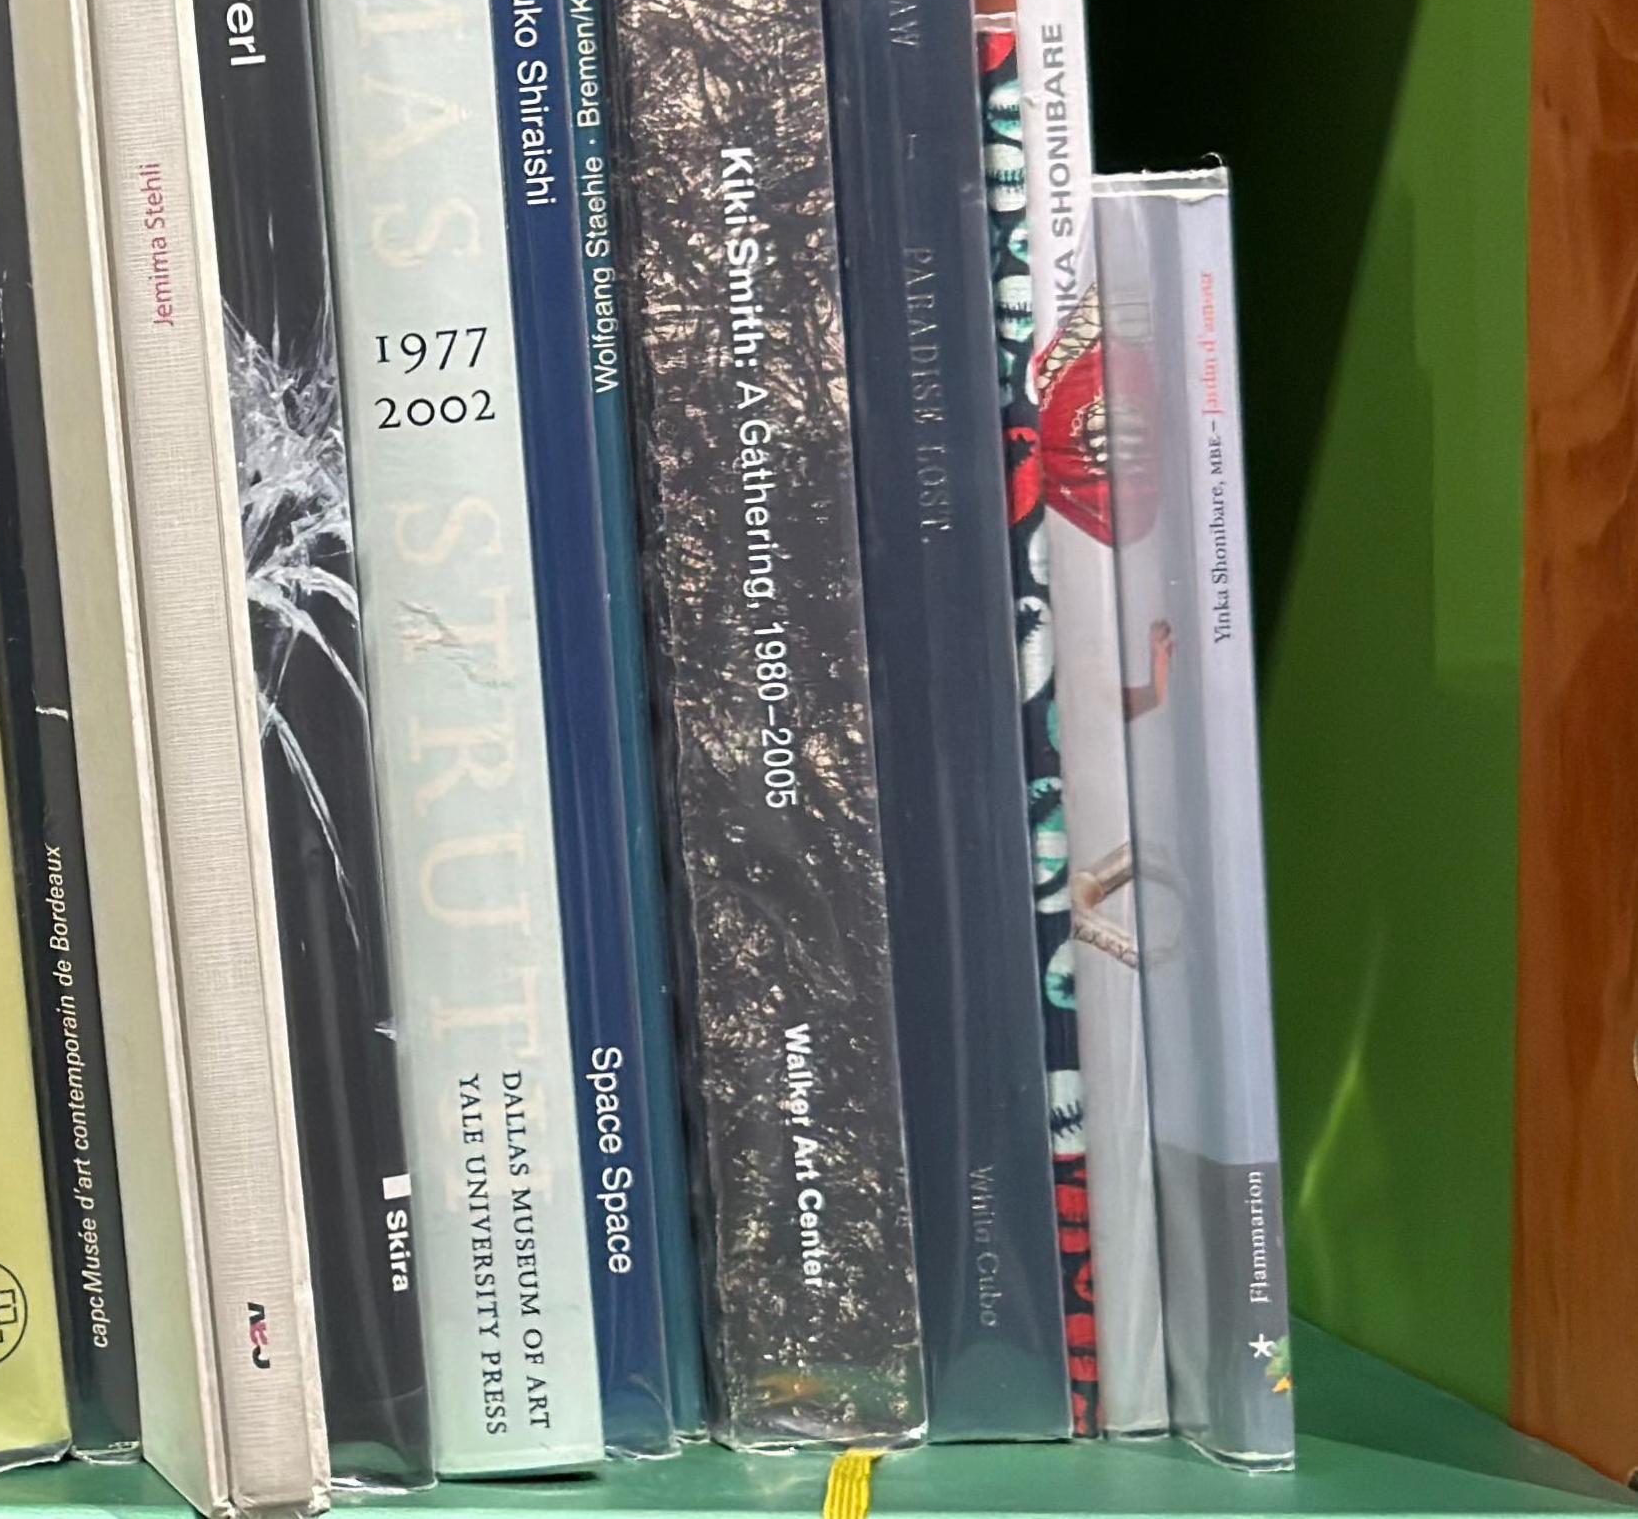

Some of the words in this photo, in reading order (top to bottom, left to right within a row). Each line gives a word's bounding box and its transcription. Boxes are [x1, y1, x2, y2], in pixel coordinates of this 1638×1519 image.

[517, 61, 556, 204] Shiraishi
[1042, 24, 1073, 237] SHONIBARE
[139, 164, 165, 229] Stehli
[581, 157, 609, 257] Staehle
[720, 147, 754, 229] Kiki
[152, 237, 174, 326] Jemima
[592, 268, 618, 392] Wolfgang
[726, 238, 764, 369] Smith:
[376, 326, 488, 375] 1977
[735, 382, 766, 410] A
[375, 388, 496, 431] 2002
[737, 419, 780, 609] Gathering,
[46, 846, 69, 951] Bordeaux
[394, 494, 555, 1218] STRUTH
[53, 960, 73, 986] de
[61, 996, 88, 1150] contemporain
[503, 1071, 529, 1176] DALLAS
[586, 1048, 622, 1153] Space
[74, 1158, 94, 1209] d'art
[597, 1167, 631, 1273] Space
[387, 1210, 410, 1291] Skira
[512, 1189, 540, 1315] MUSEUM
[1249, 1172, 1270, 1302] Flammarion
[523, 1329, 544, 1364] OF
[527, 1376, 550, 1428] ART
